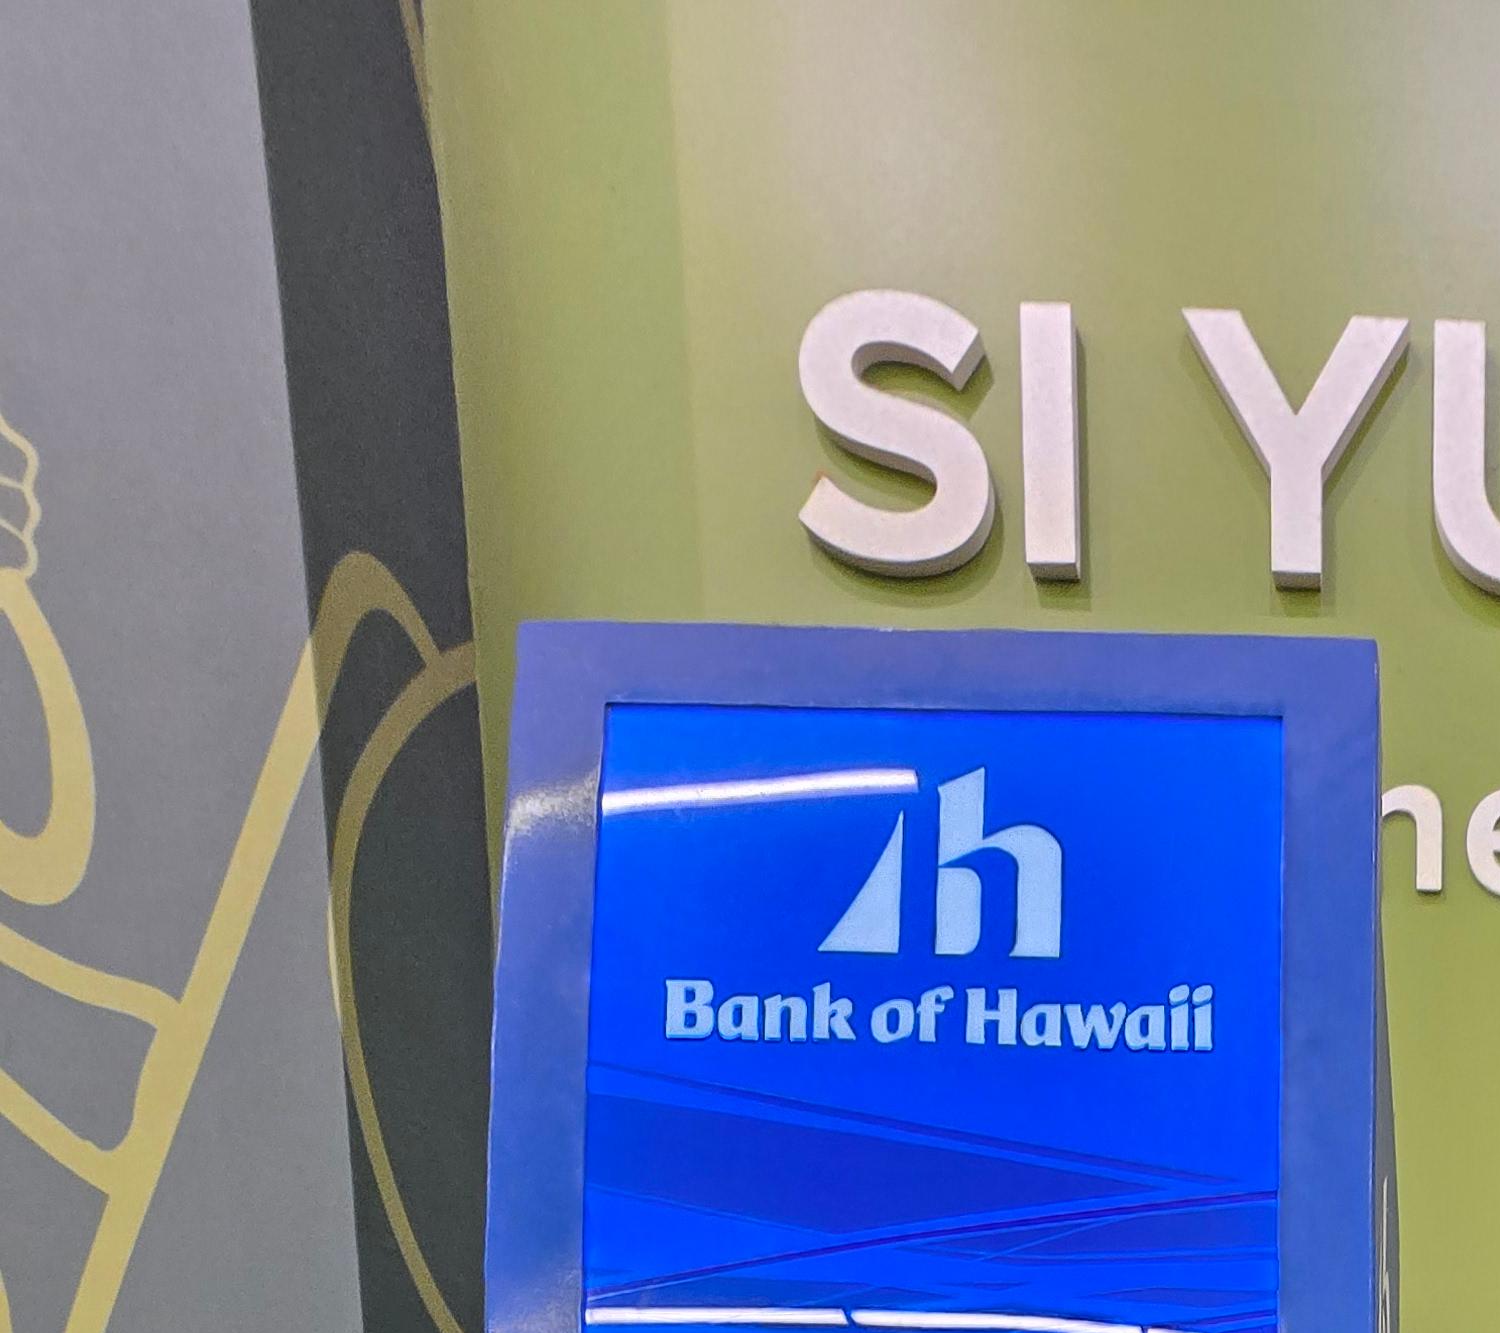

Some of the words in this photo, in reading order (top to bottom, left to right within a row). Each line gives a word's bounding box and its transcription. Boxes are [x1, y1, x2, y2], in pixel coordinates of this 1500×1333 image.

[799, 288, 1080, 580] SI
[664, 978, 857, 1044] Bank
[871, 985, 954, 1044] of
[965, 984, 1215, 1052] Hawaii
